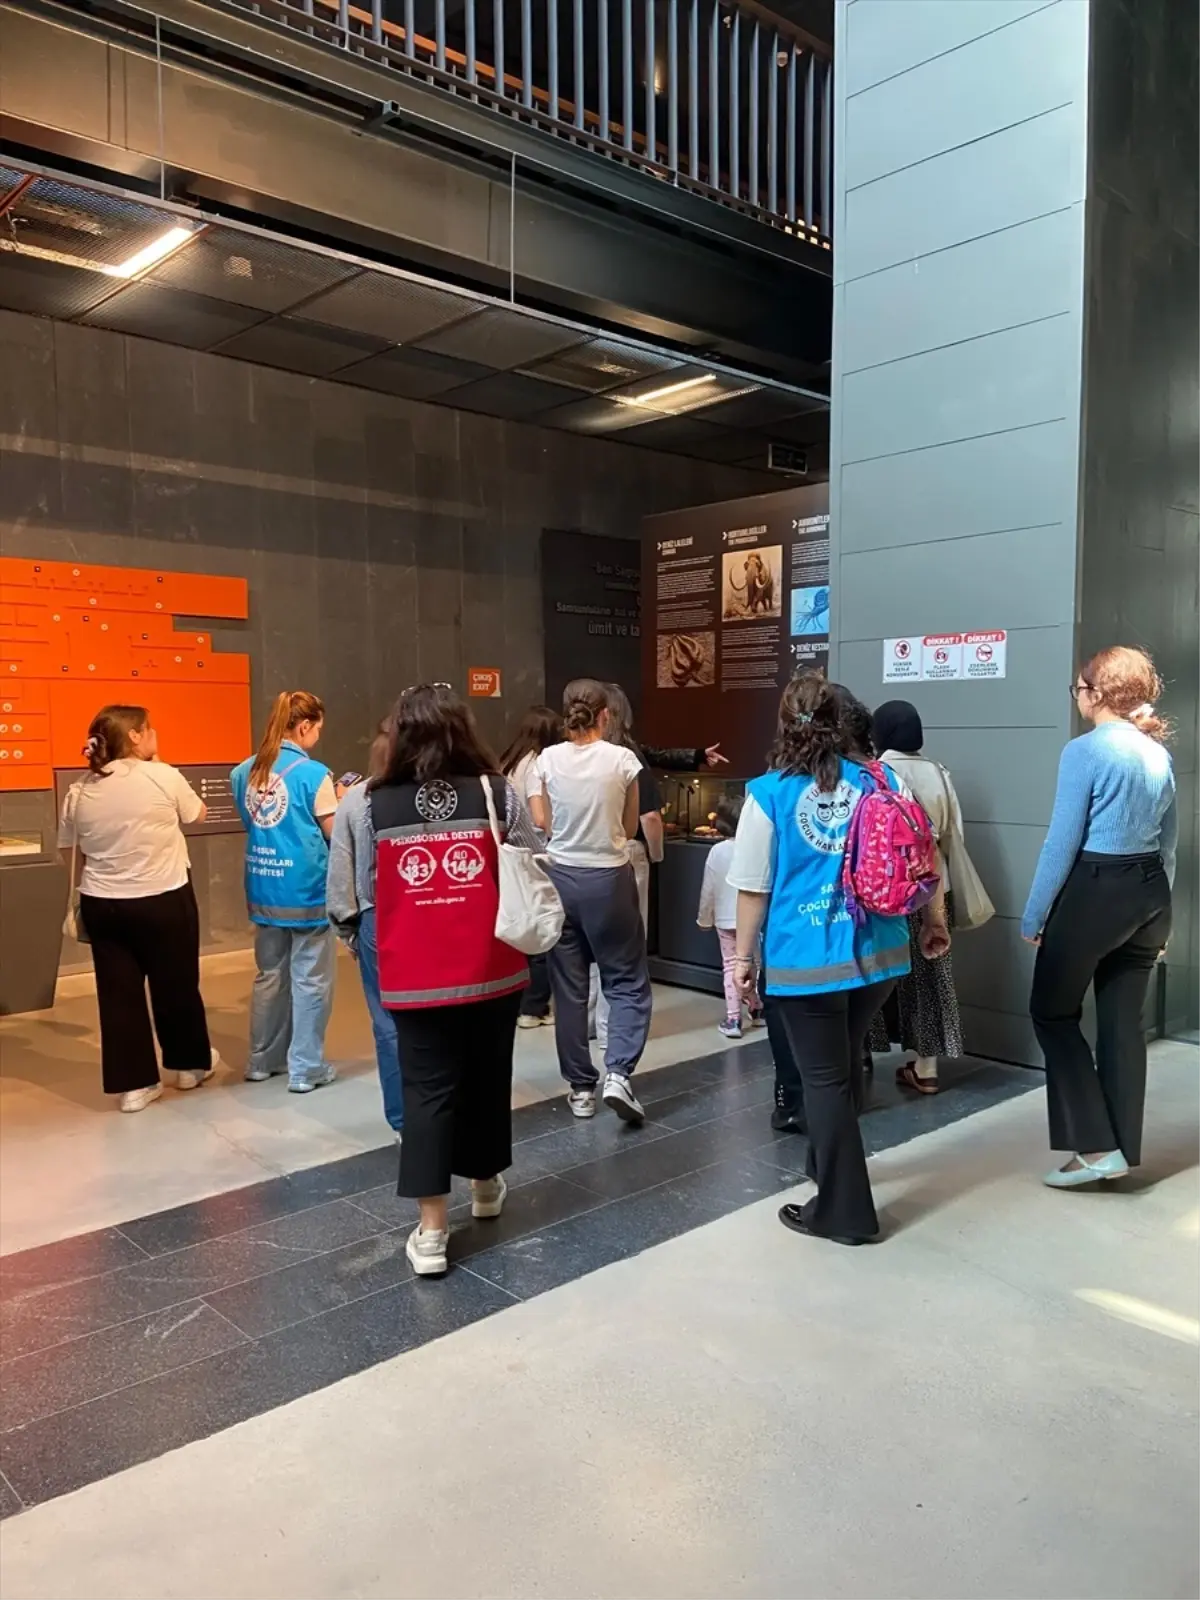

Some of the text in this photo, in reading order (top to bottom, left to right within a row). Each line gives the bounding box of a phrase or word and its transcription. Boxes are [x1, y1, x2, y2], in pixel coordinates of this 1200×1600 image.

[616, 624, 627, 636] ve
[926, 636, 953, 646] DİKKAT
[967, 633, 995, 643] DİKKAT
[389, 832, 450, 847] PSİKOSOSYAL
[815, 839, 846, 852] HAKLA
[404, 863, 429, 879] 183
[450, 859, 477, 875] 144
